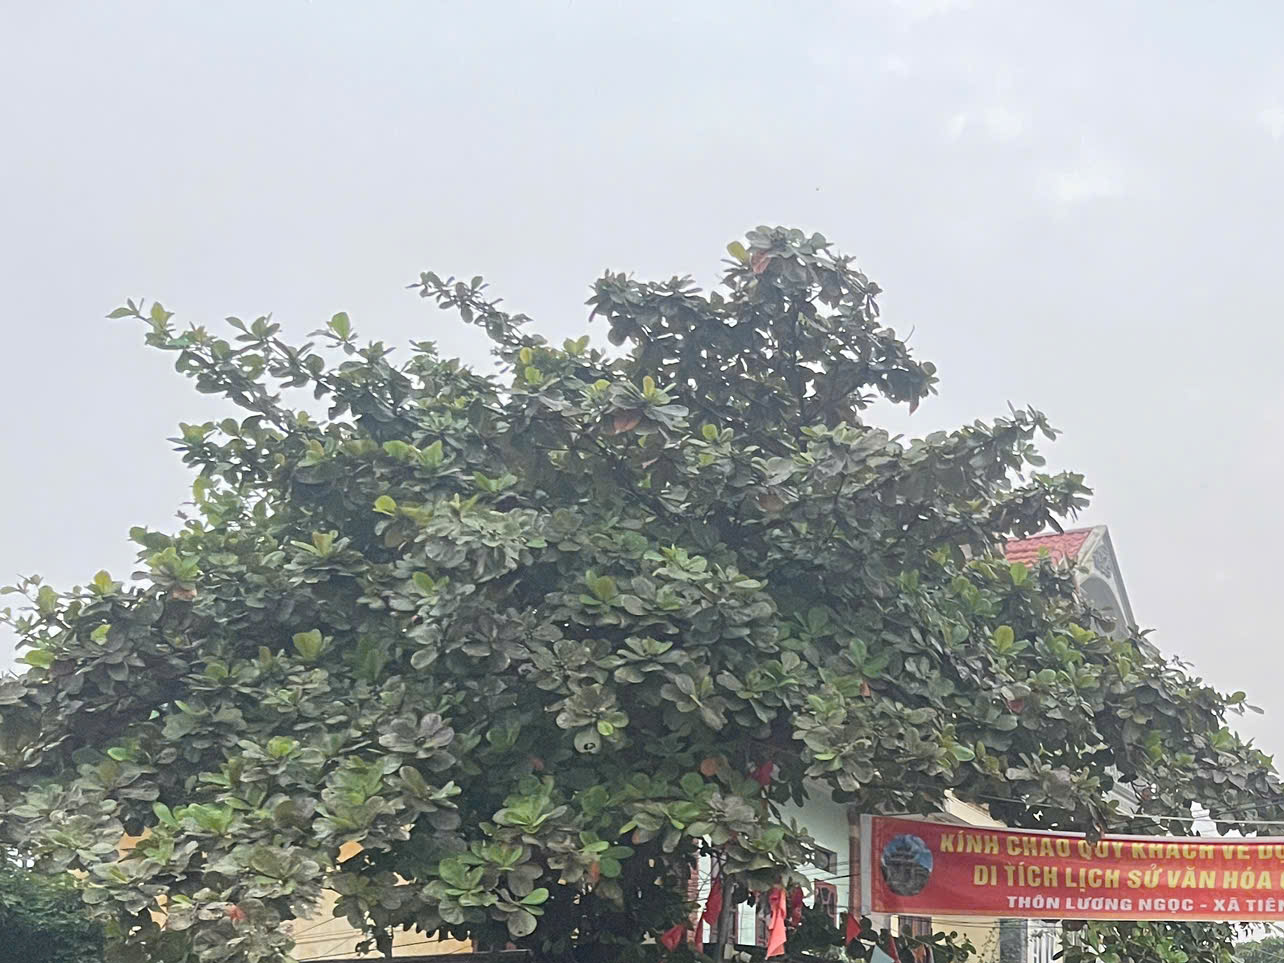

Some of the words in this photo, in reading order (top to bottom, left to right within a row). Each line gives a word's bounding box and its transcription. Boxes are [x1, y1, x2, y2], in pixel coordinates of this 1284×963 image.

[973, 865, 998, 886] DI
[1005, 862, 1058, 887] TÍCH
[1065, 867, 1120, 892] LỊCH
[1127, 863, 1162, 888] SỬ
[1167, 866, 1216, 889] VĂN
[1222, 866, 1272, 889] HÓA
[1007, 894, 1060, 909] THÔN
[1065, 897, 1132, 911] LƯƠNG
[1138, 898, 1194, 913] NGỌC
[1213, 896, 1240, 912] XÃ
